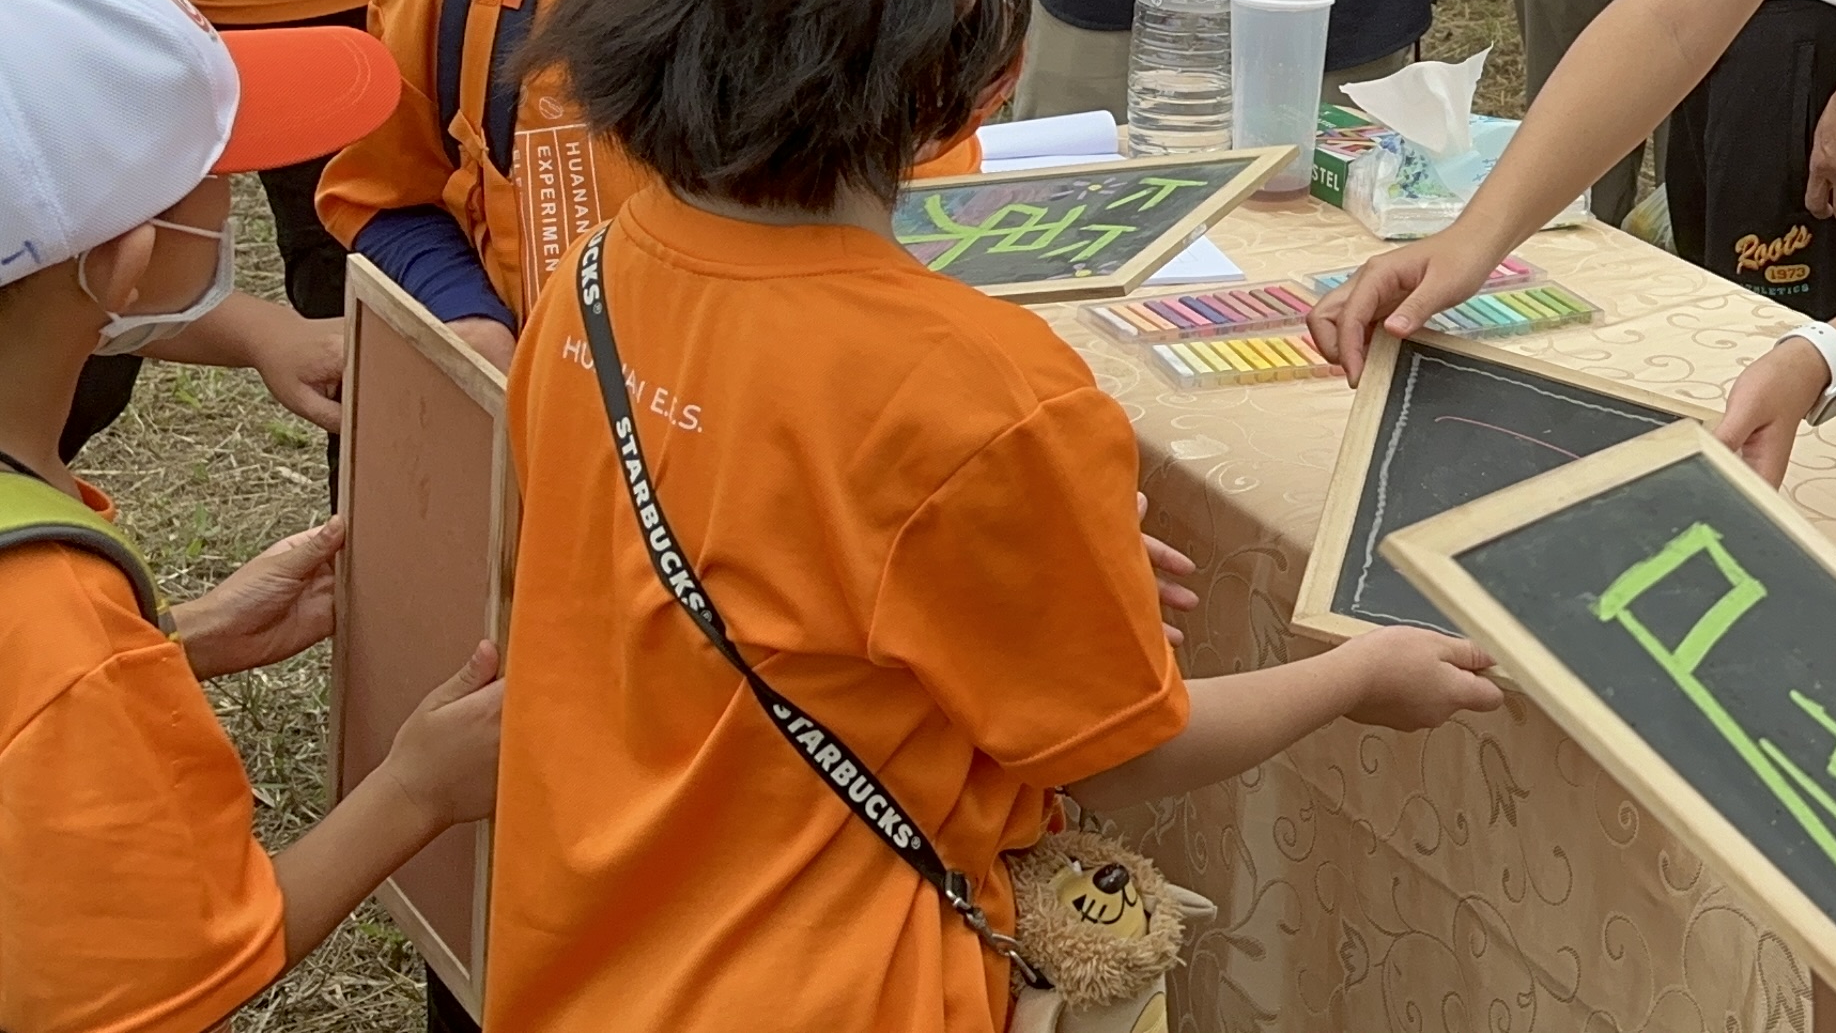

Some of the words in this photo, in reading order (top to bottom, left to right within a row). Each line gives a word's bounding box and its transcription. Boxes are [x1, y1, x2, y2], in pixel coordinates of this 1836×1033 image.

[565, 141, 591, 235] HUANAN
[1734, 224, 1813, 275] Roots
[1769, 267, 1806, 280] 1973
[1742, 283, 1810, 296] THLETICS
[615, 416, 706, 612] STARBUCKS
